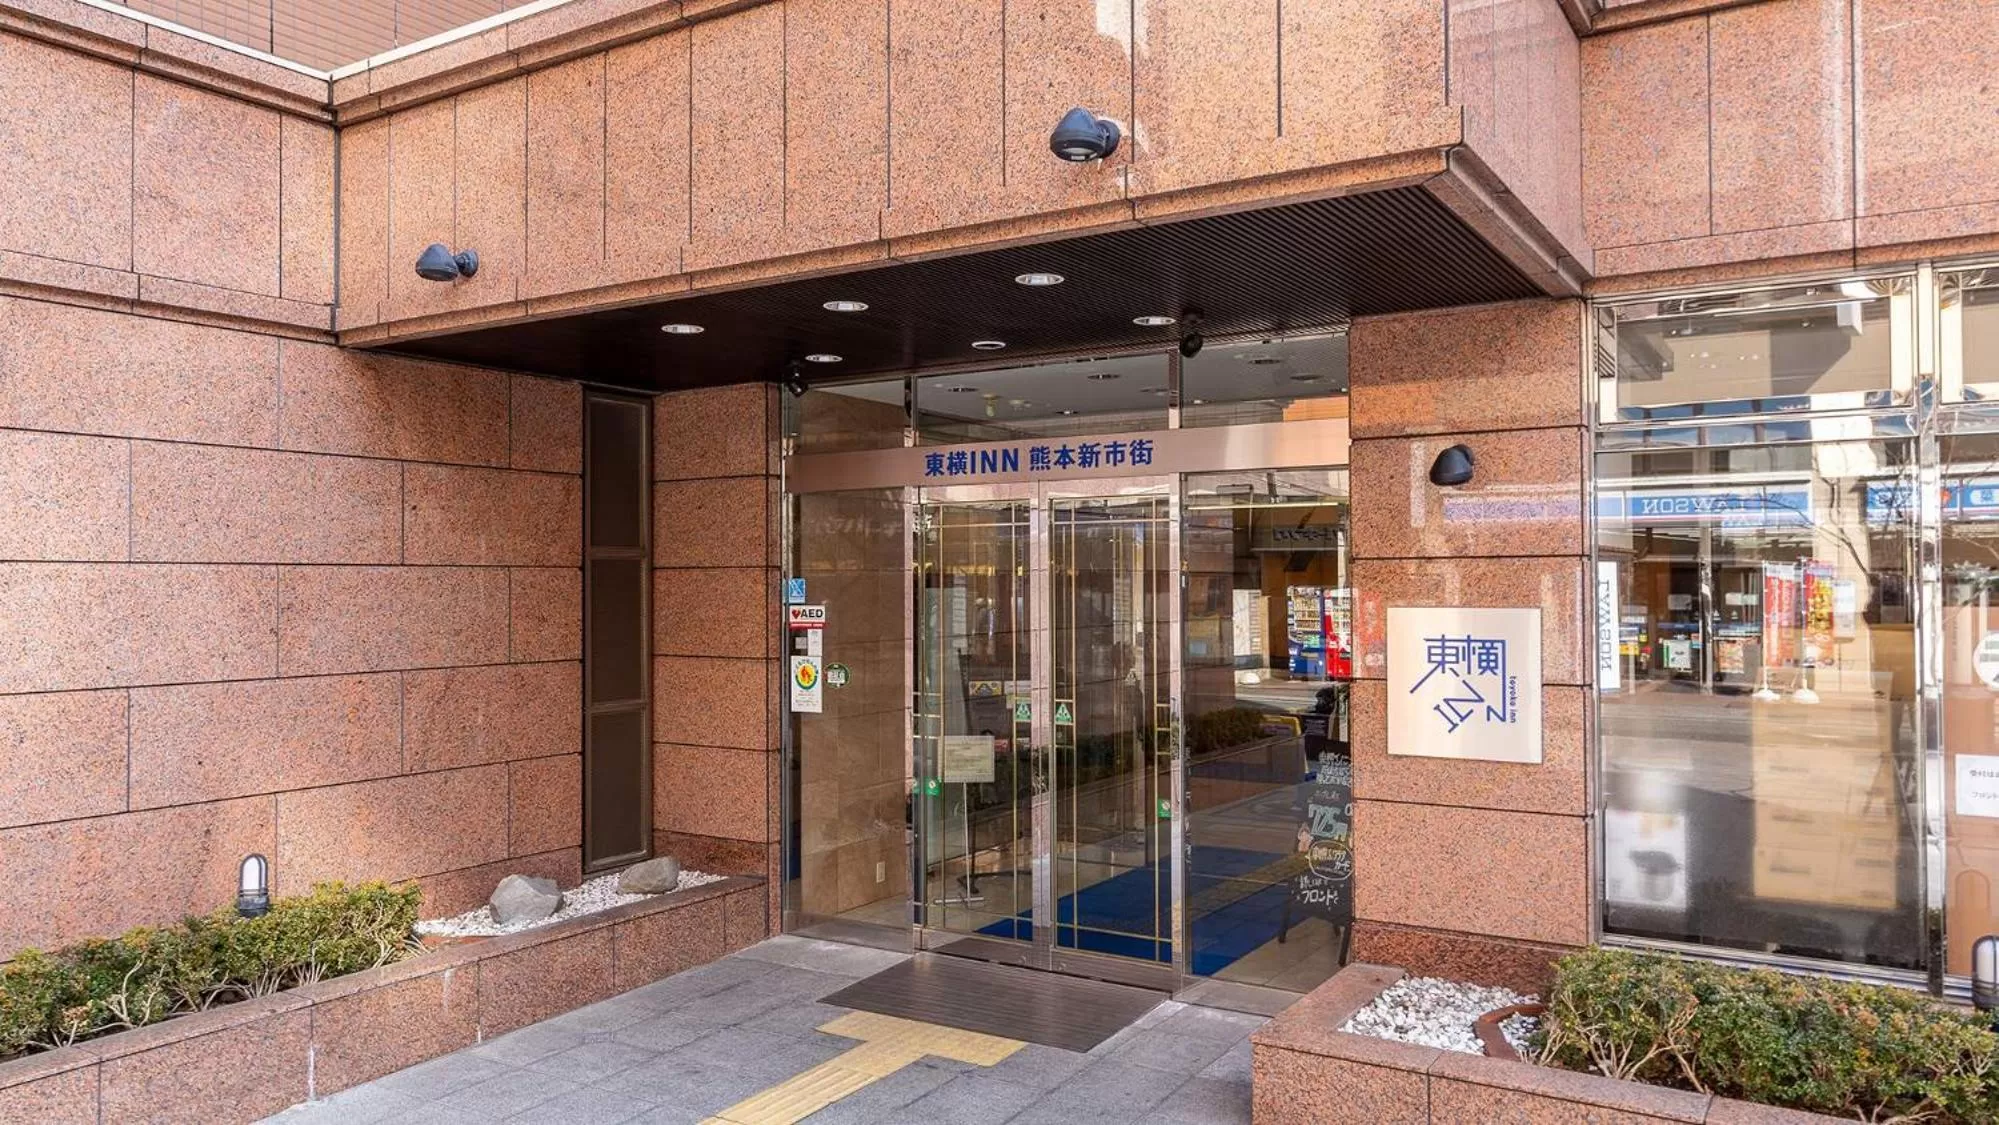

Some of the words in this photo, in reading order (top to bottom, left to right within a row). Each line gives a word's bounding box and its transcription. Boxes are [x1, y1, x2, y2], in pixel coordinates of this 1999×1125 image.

[925, 447, 1019, 477] 東横INN
[1029, 439, 1153, 471] 熊本新市街
[800, 608, 824, 618] AED
[1508, 676, 1517, 706] toyoko
[1509, 709, 1517, 724] inn
